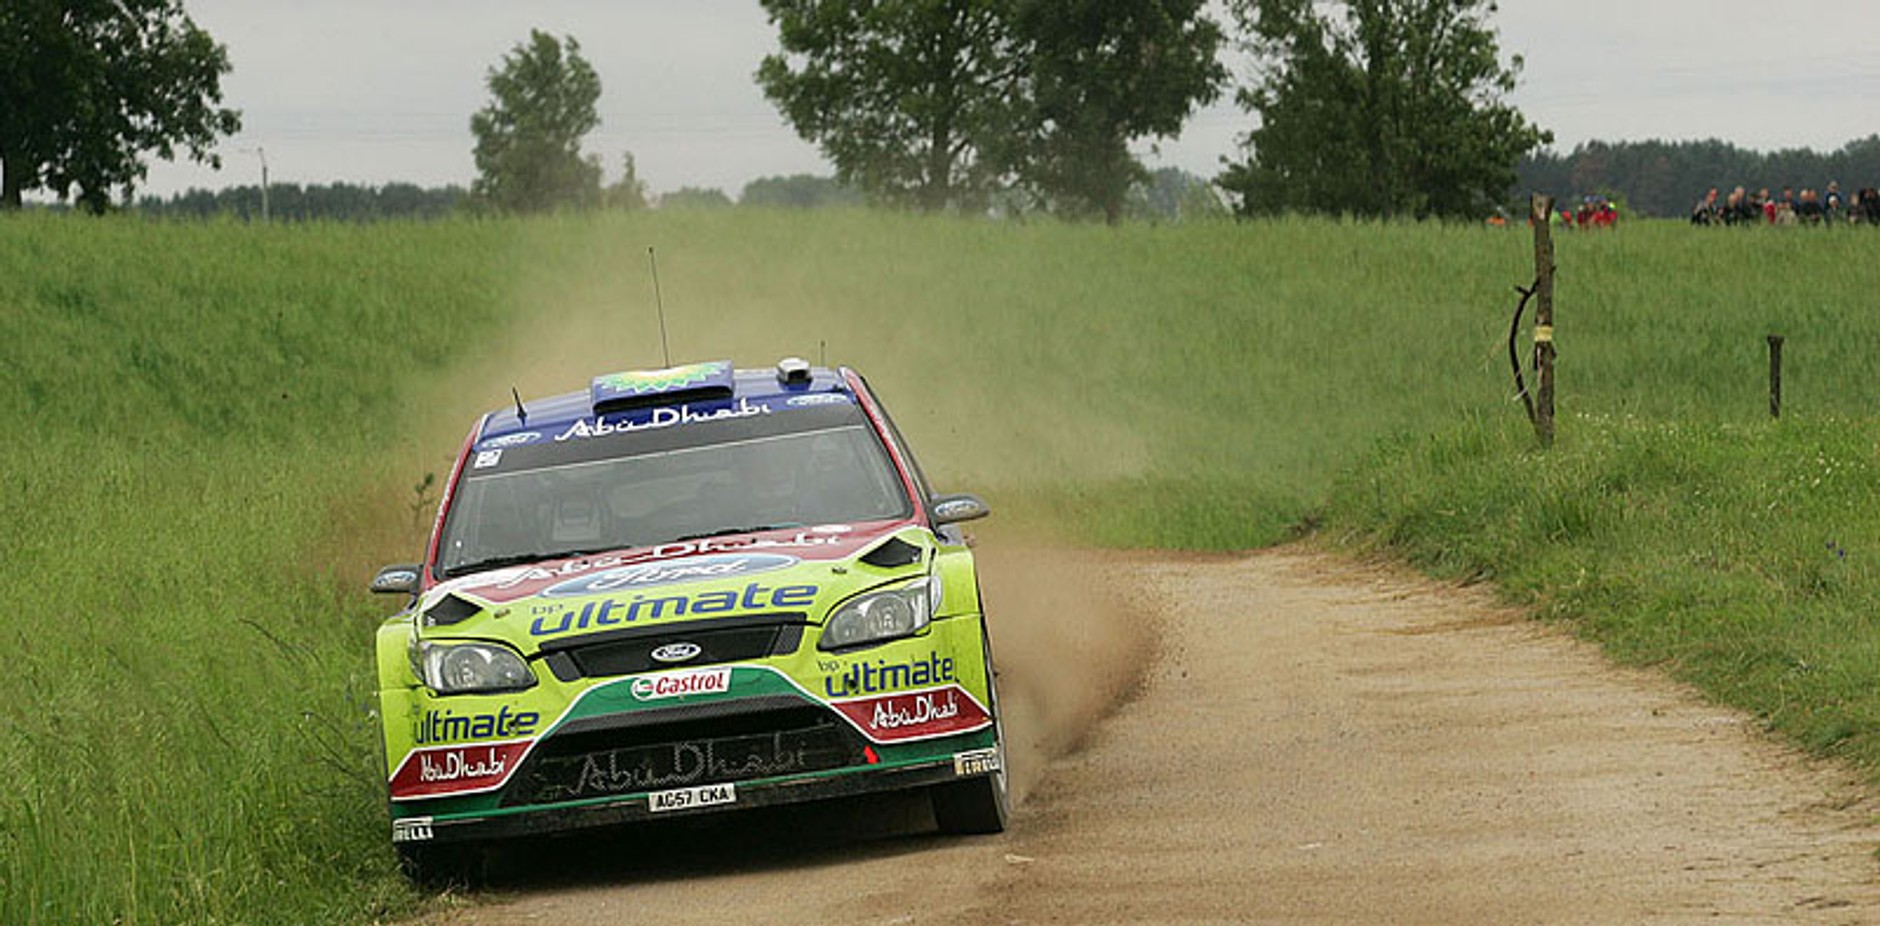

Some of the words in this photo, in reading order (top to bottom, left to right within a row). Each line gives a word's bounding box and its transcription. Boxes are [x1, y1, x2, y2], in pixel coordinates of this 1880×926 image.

[530, 583, 819, 636] ultimate
[656, 672, 724, 694] Castrol
[826, 651, 953, 697] ultimate
[414, 706, 540, 743] ultimate
